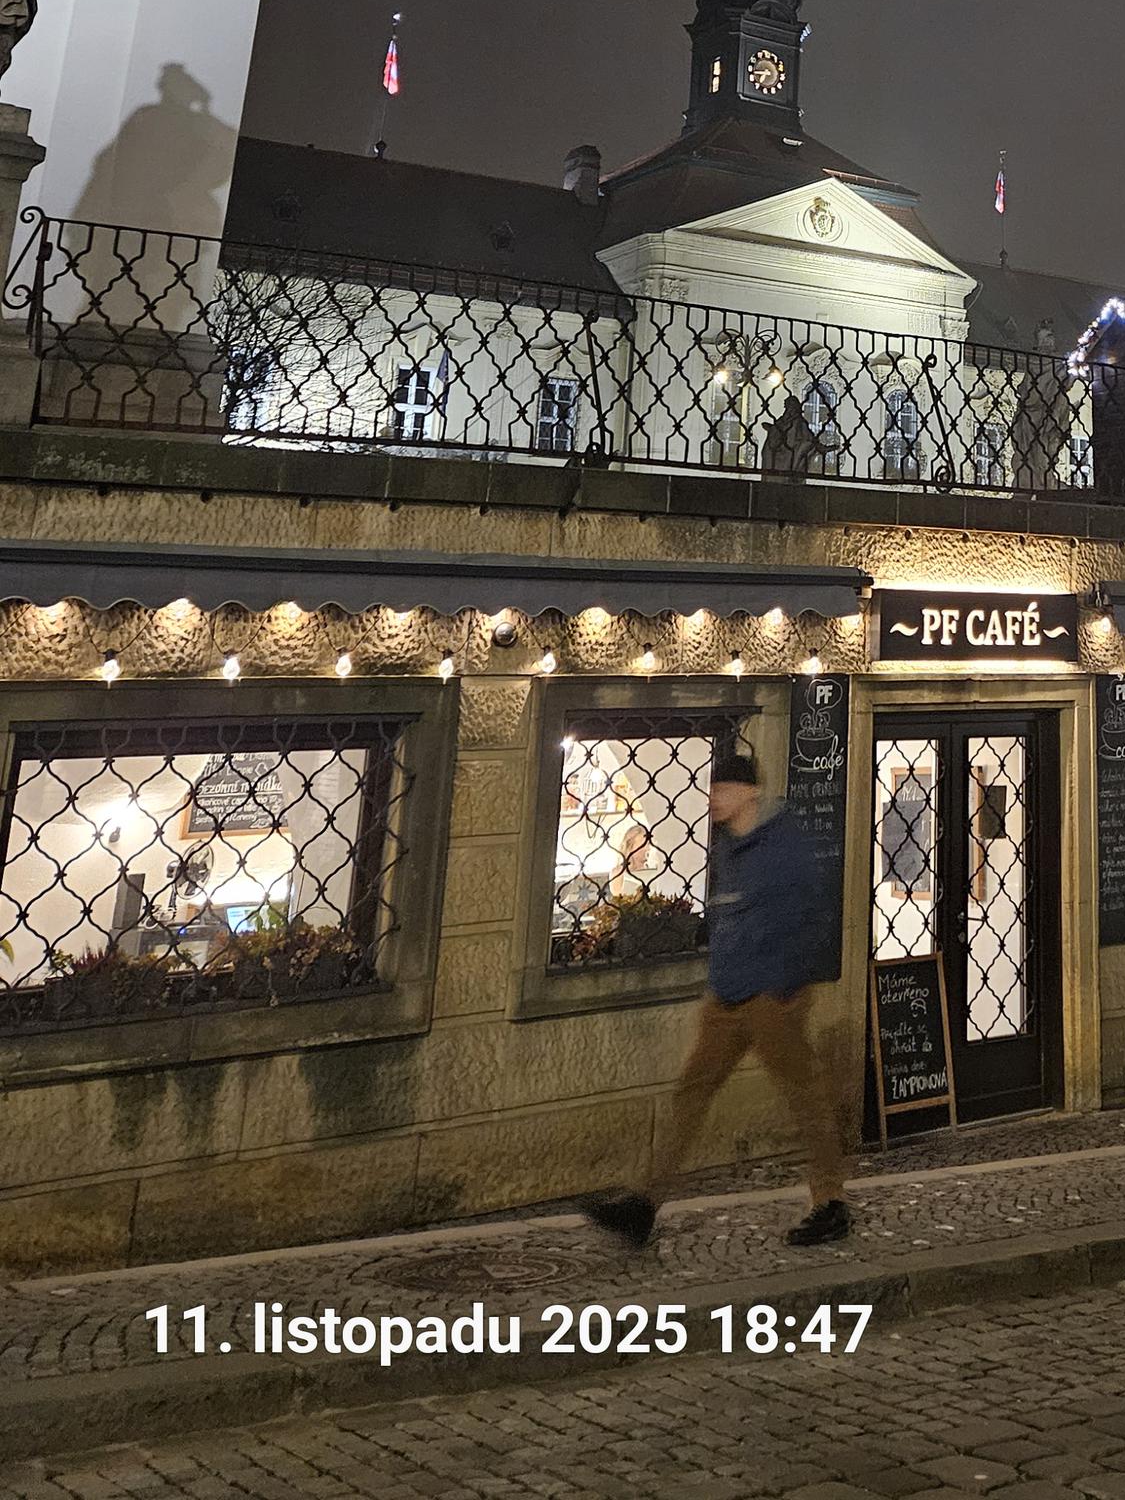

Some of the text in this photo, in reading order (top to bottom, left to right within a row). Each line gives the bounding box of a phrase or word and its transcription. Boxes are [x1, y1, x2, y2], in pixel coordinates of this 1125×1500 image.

[921, 601, 1042, 647] PF CAFÉ
[815, 684, 833, 705] PF
[812, 734, 845, 781] café
[878, 974, 917, 991] Máme
[881, 987, 930, 1005] otevřeno
